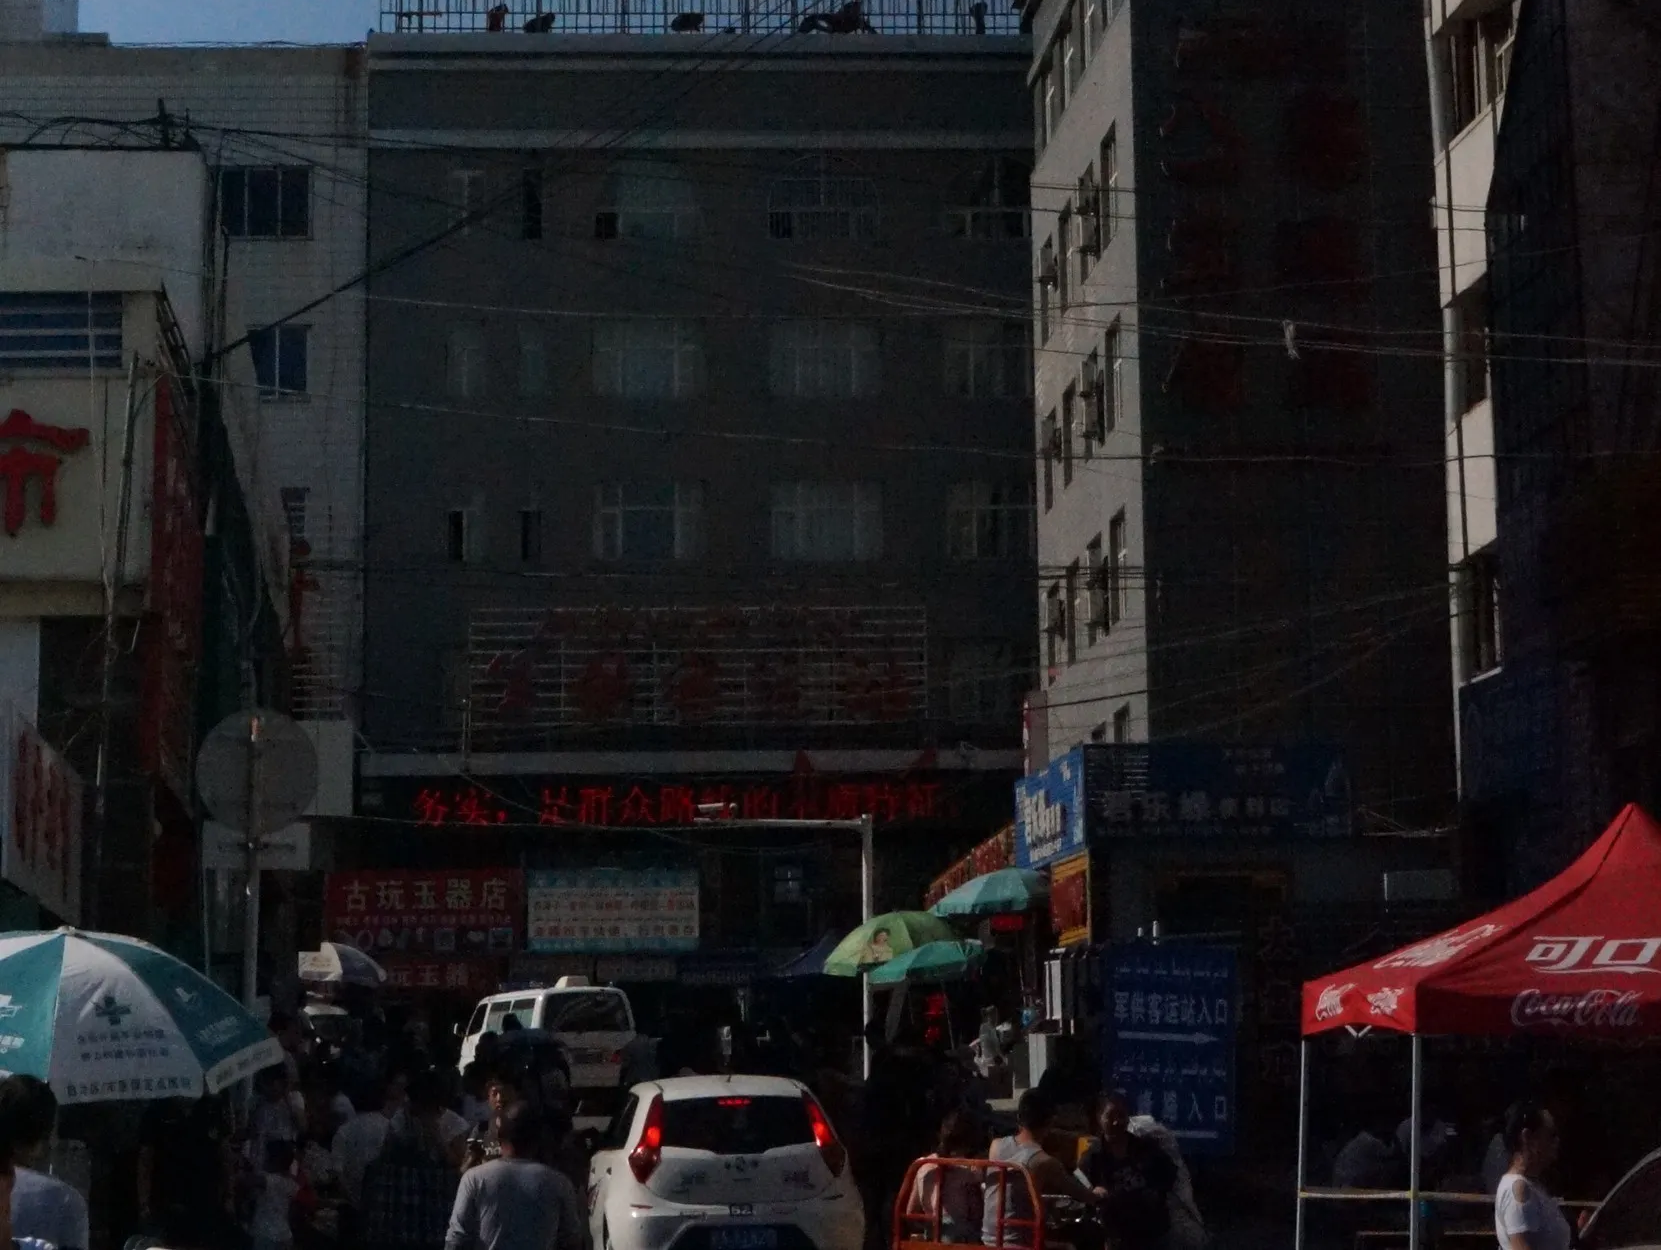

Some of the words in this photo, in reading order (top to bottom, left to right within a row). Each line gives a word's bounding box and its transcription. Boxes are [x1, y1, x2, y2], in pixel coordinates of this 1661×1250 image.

[342, 877, 509, 911] 古玩玉器店
